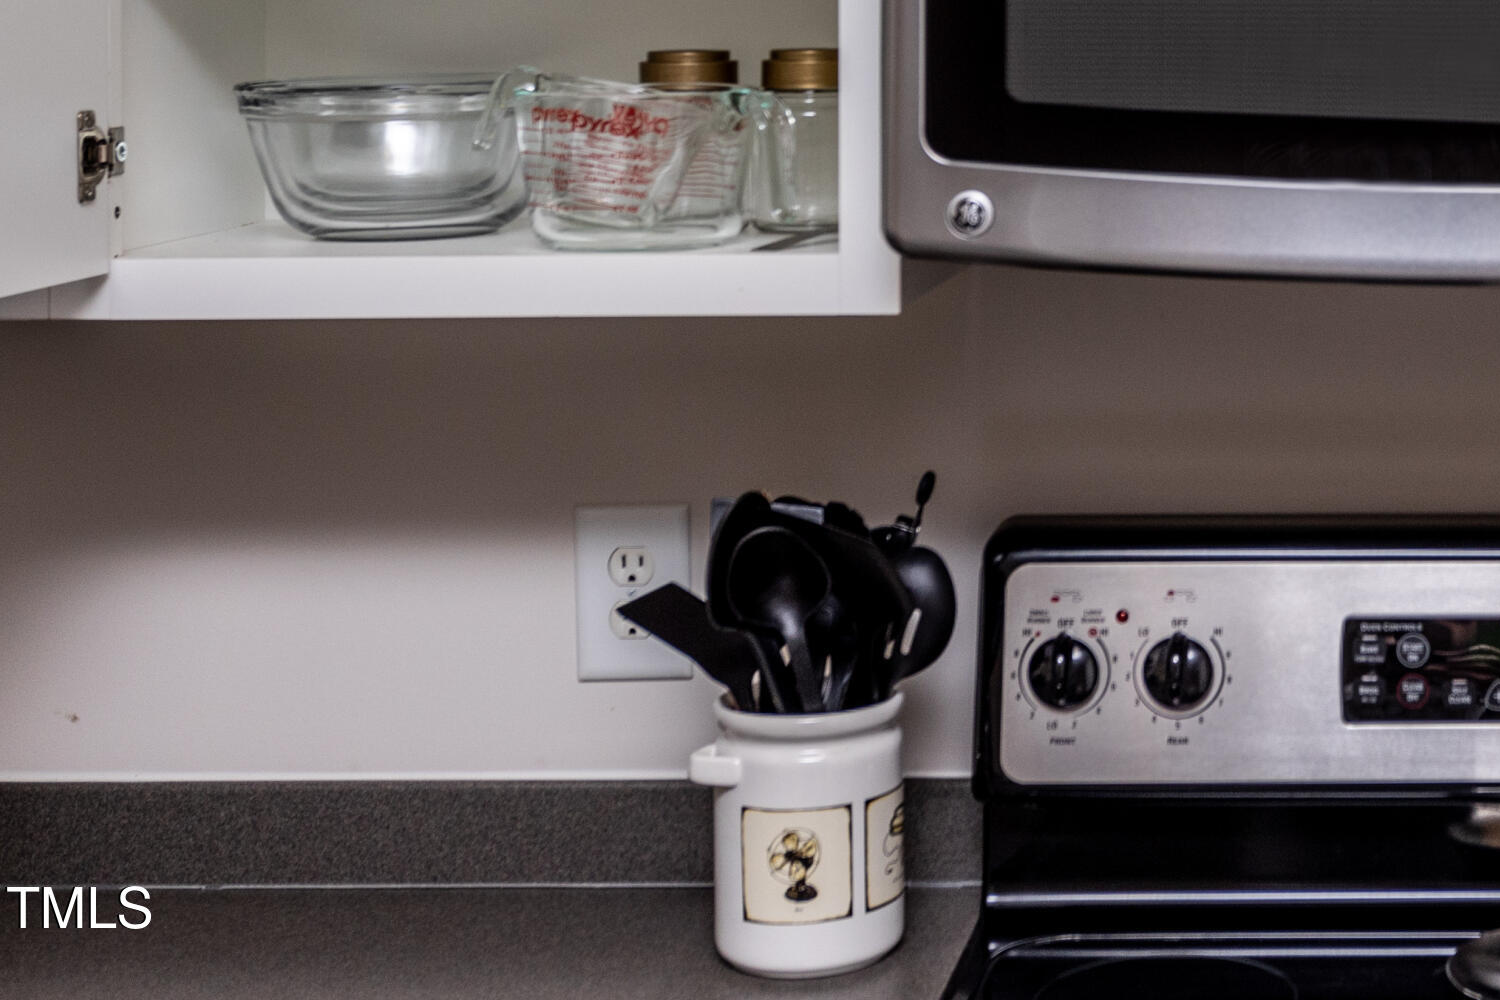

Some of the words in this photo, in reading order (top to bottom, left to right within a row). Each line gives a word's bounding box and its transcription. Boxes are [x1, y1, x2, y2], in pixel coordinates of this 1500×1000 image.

[571, 112, 642, 139] pyrex
[1057, 618, 1074, 627] OFF
[1171, 618, 1189, 627] OFF
[1167, 737, 1189, 745] REAR
